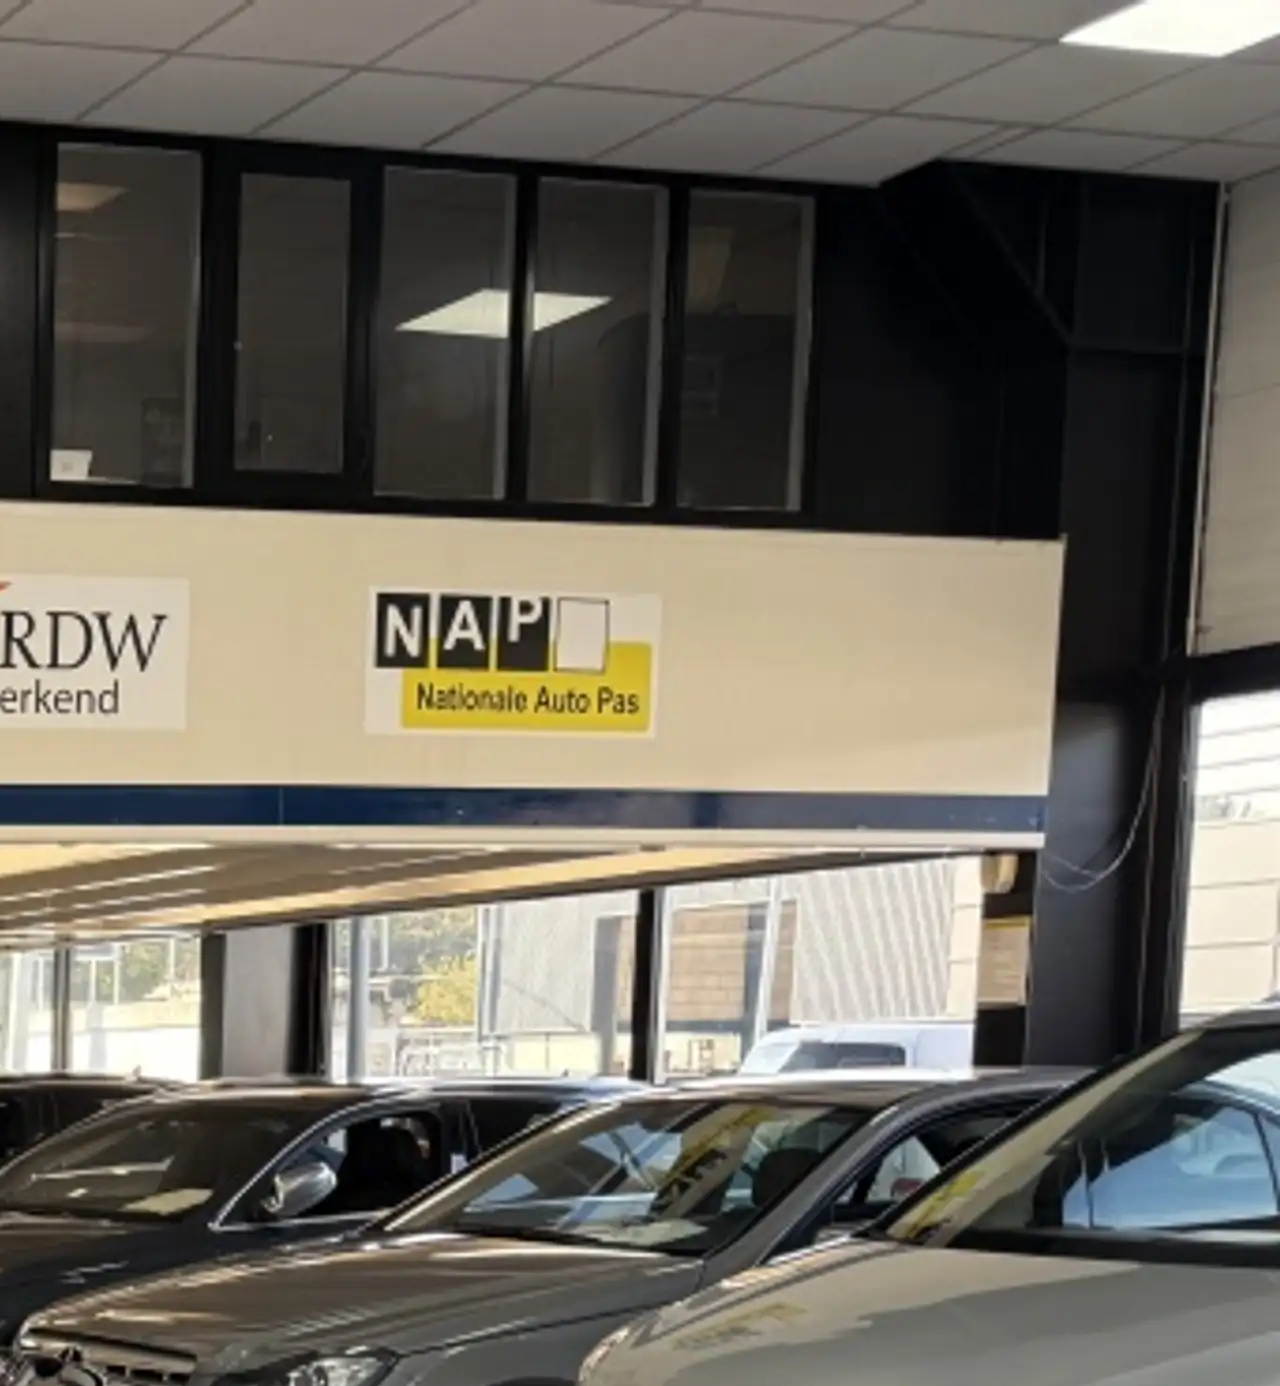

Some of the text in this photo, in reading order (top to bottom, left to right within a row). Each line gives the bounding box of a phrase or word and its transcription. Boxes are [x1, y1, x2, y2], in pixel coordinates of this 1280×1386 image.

[382, 596, 545, 660] NAP
[416, 682, 640, 715] Nationale Auto Pas
